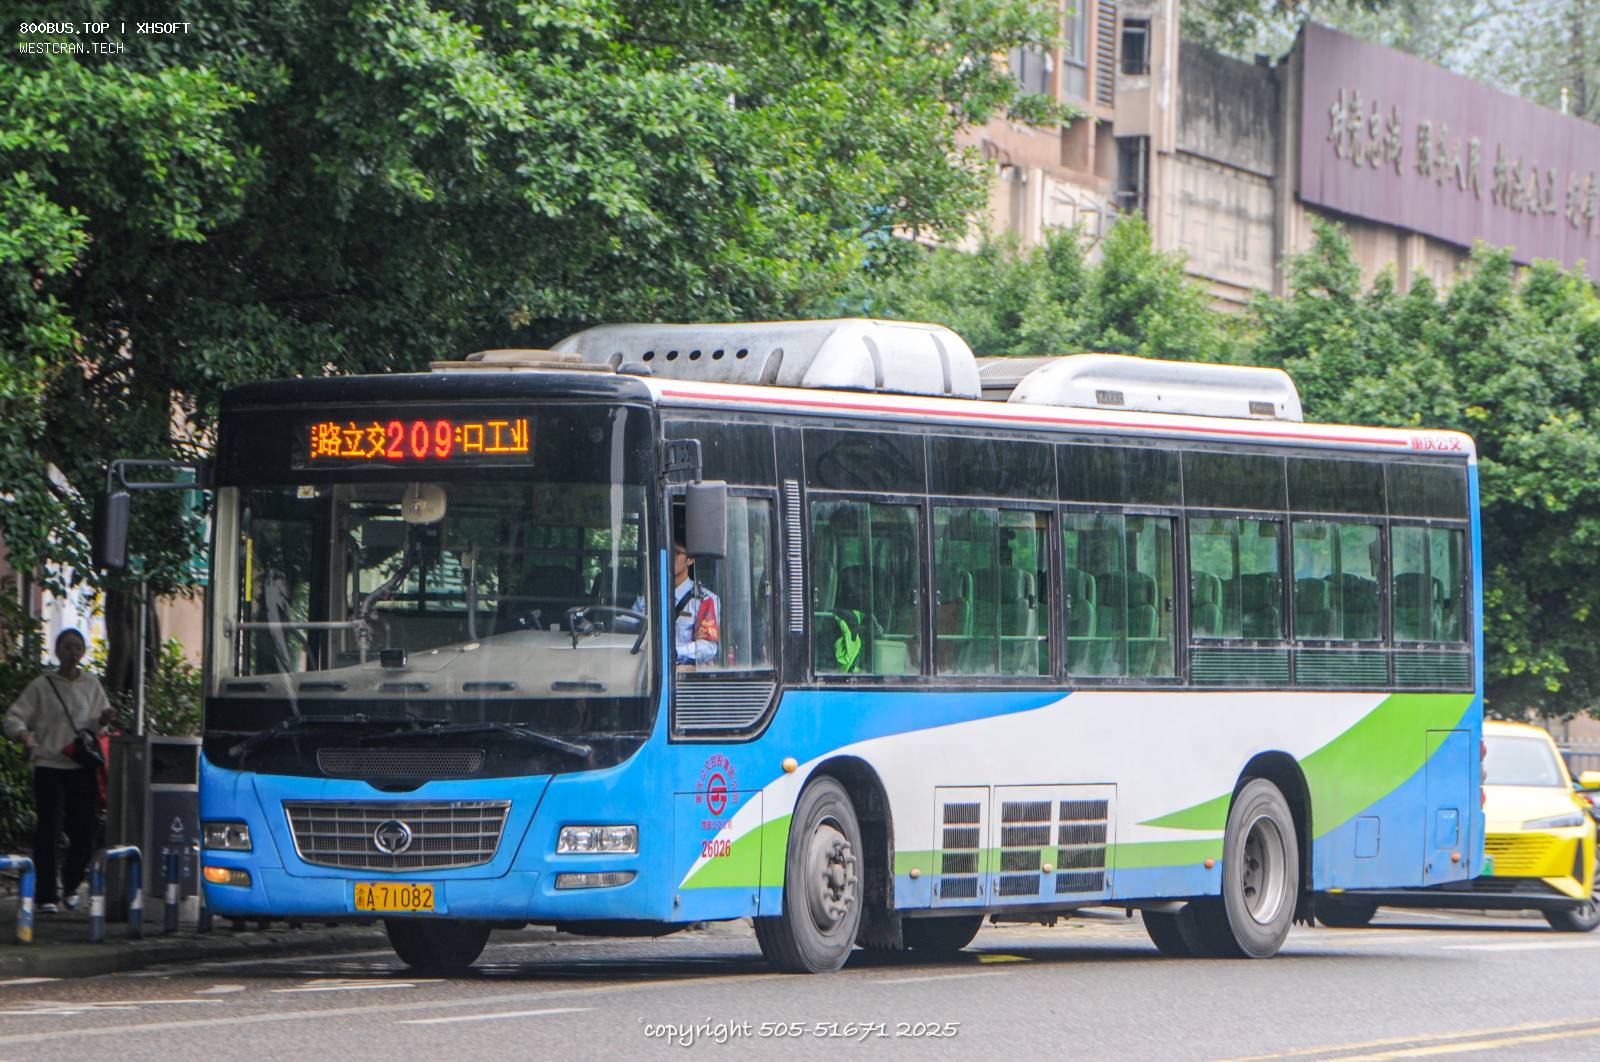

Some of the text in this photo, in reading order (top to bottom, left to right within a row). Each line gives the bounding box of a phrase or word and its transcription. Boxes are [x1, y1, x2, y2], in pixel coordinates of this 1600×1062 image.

[311, 419, 529, 459] 路立交 209 口工业
[1410, 436, 1462, 451] 重庆公交
[701, 839, 732, 858] 26026
